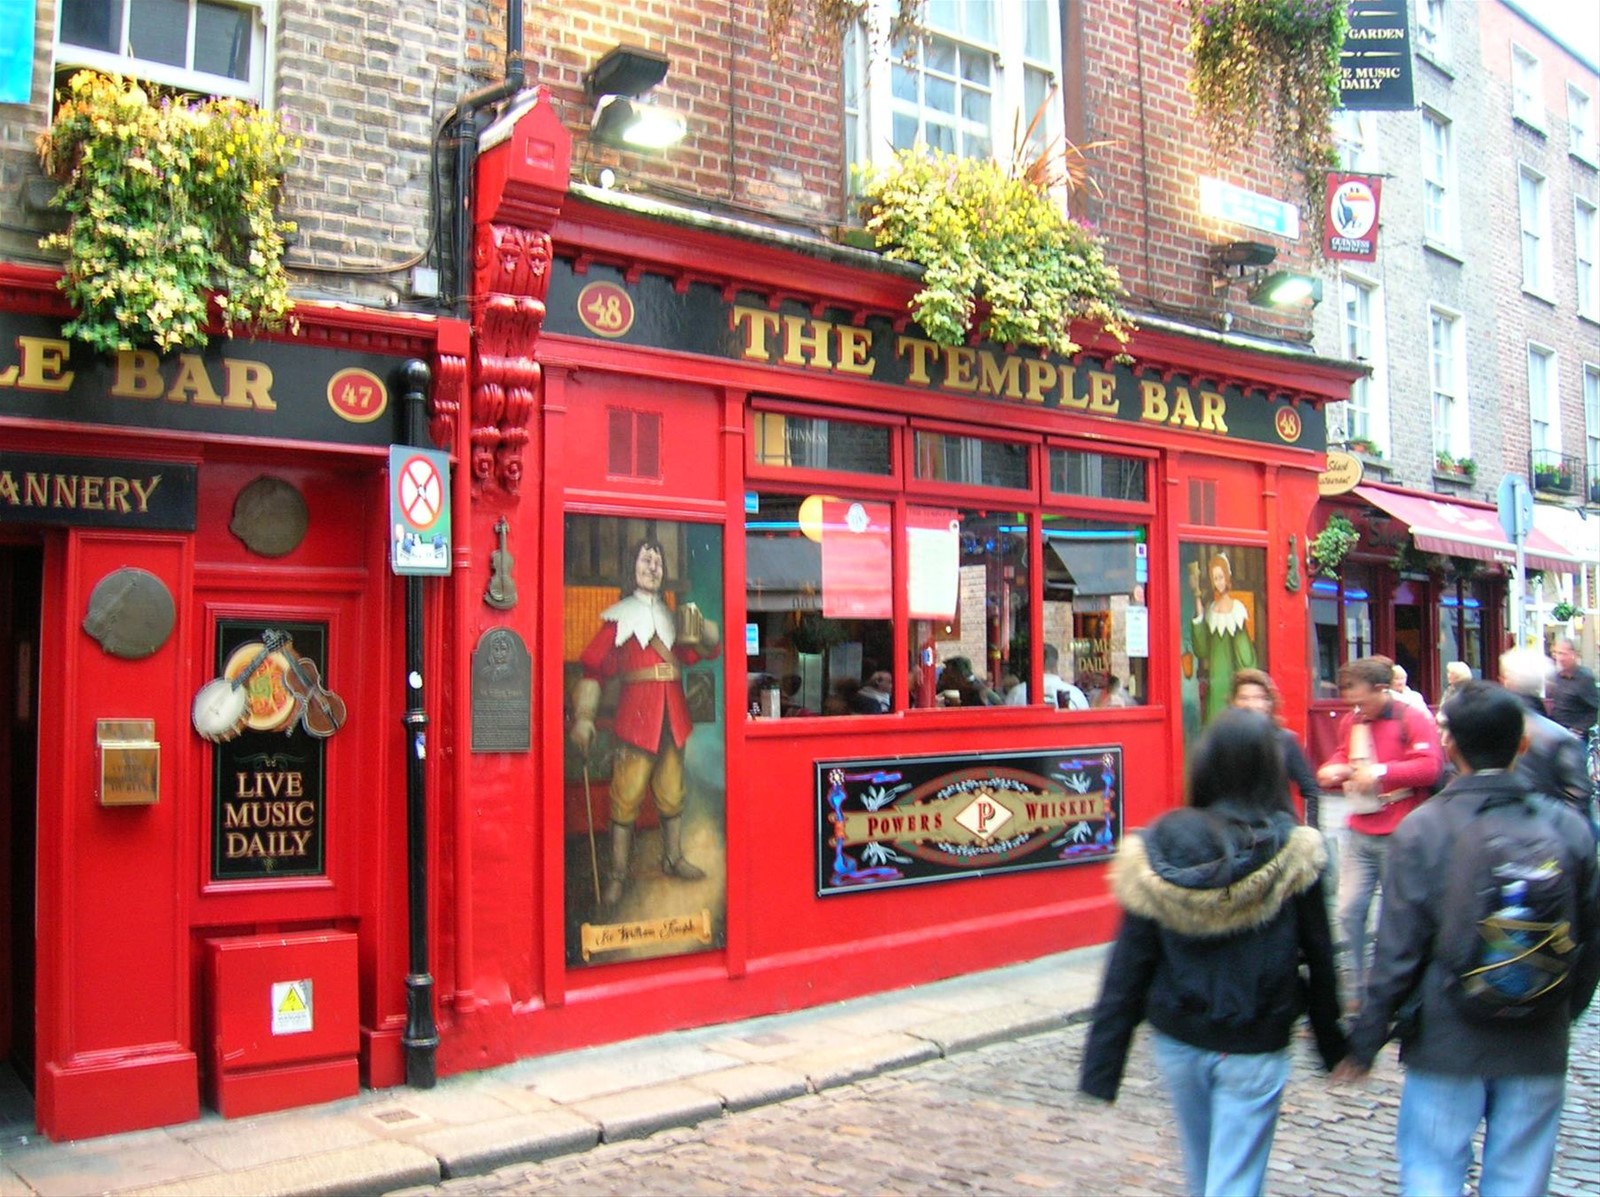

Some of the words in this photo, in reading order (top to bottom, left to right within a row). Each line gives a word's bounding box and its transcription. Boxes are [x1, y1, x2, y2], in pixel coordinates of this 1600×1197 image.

[1348, 28, 1404, 40] GARDEN
[1339, 66, 1354, 79] E
[1355, 66, 1401, 79] MUSIC
[1340, 78, 1383, 90] DAILY
[1331, 237, 1370, 249] GUINNESS
[587, 292, 623, 330] 48
[109, 349, 277, 412] BAR
[731, 305, 876, 377] THE
[897, 337, 1120, 415] TEMPLE
[1139, 380, 1229, 434] BAR
[341, 383, 373, 409] 47
[782, 426, 828, 444] GUINNESS
[1279, 412, 1298, 434] 48
[1078, 656, 1112, 673] DAILY
[235, 771, 304, 798] LIVE
[224, 801, 315, 829] MUSIC
[867, 811, 943, 837] POWERS
[976, 801, 996, 834] P
[1025, 799, 1097, 822] WHISKEY
[225, 830, 314, 859] DAILY
